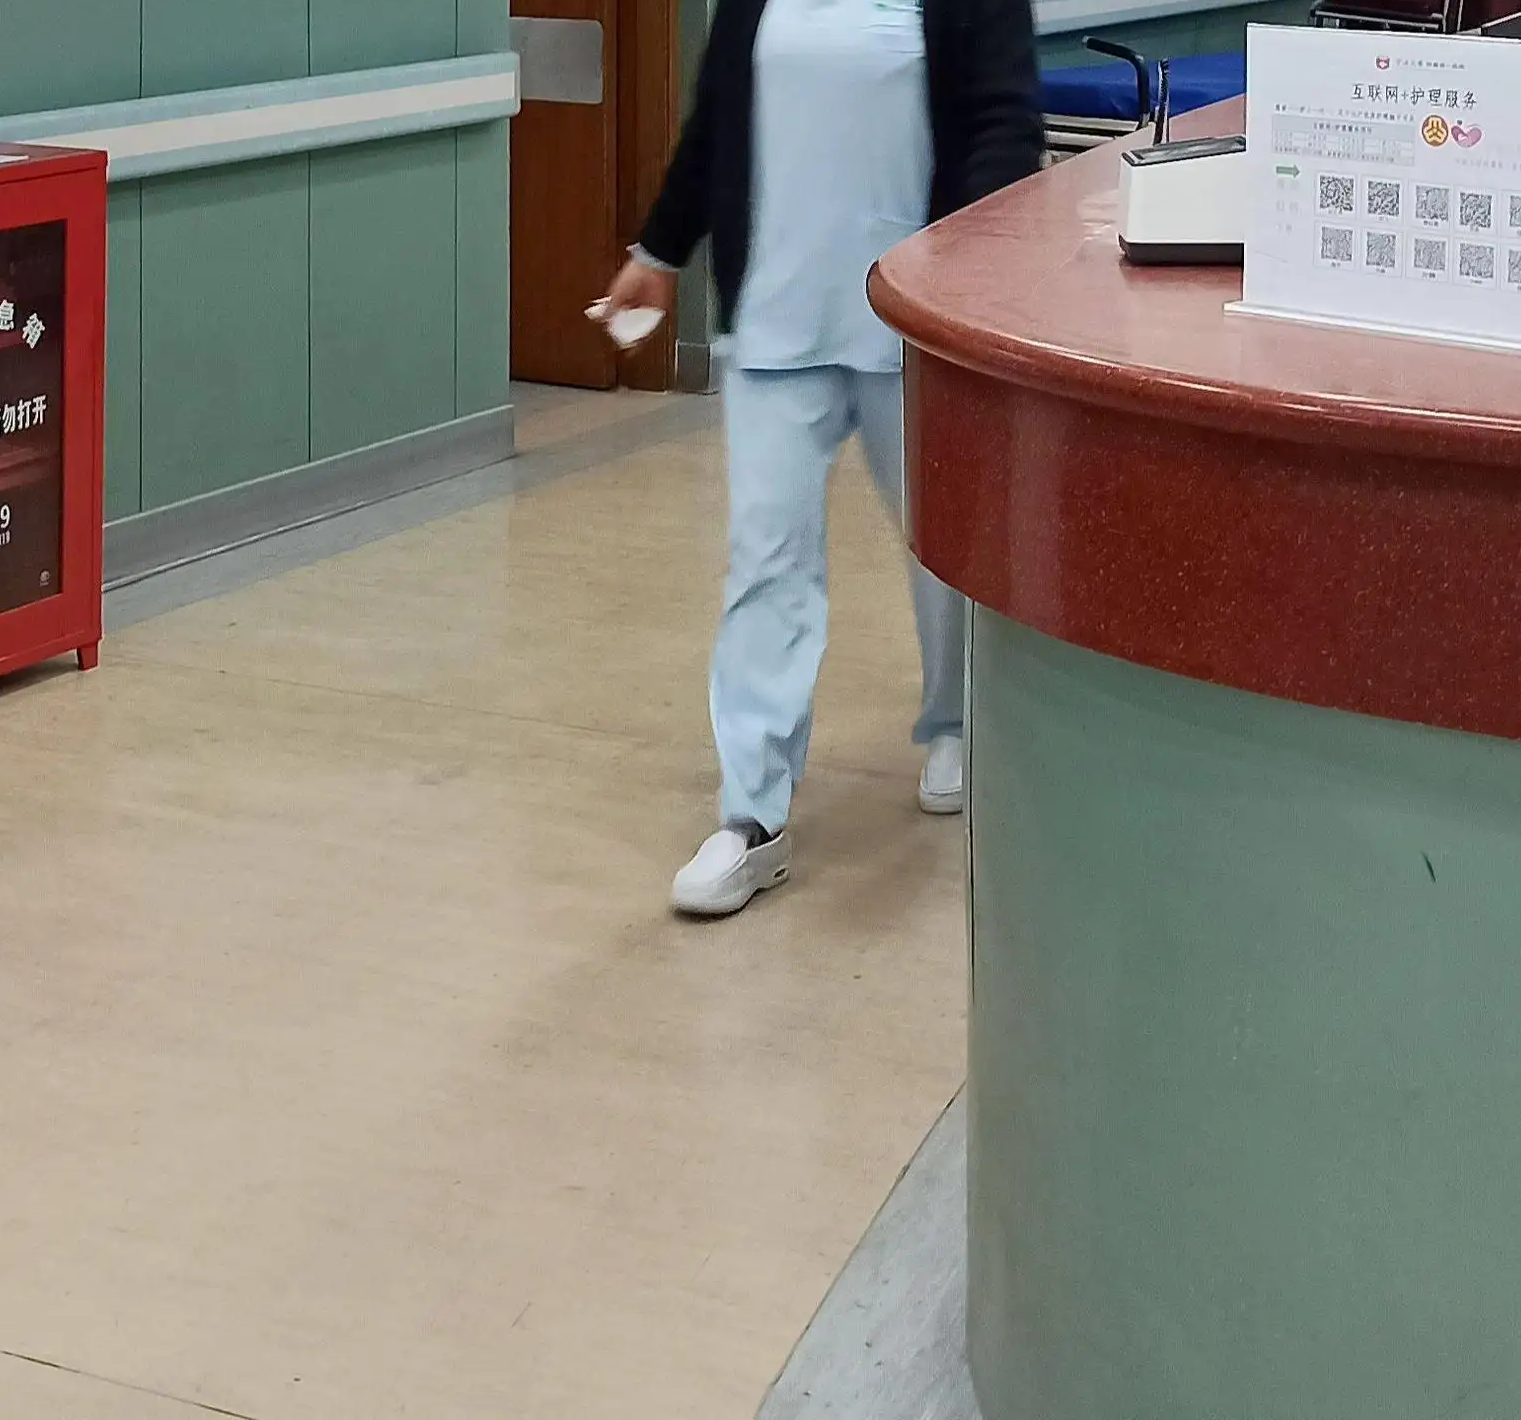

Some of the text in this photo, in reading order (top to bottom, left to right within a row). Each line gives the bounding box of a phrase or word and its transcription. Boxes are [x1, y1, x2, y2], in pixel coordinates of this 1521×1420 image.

[1350, 82, 1479, 110] 互联网+护理服务
